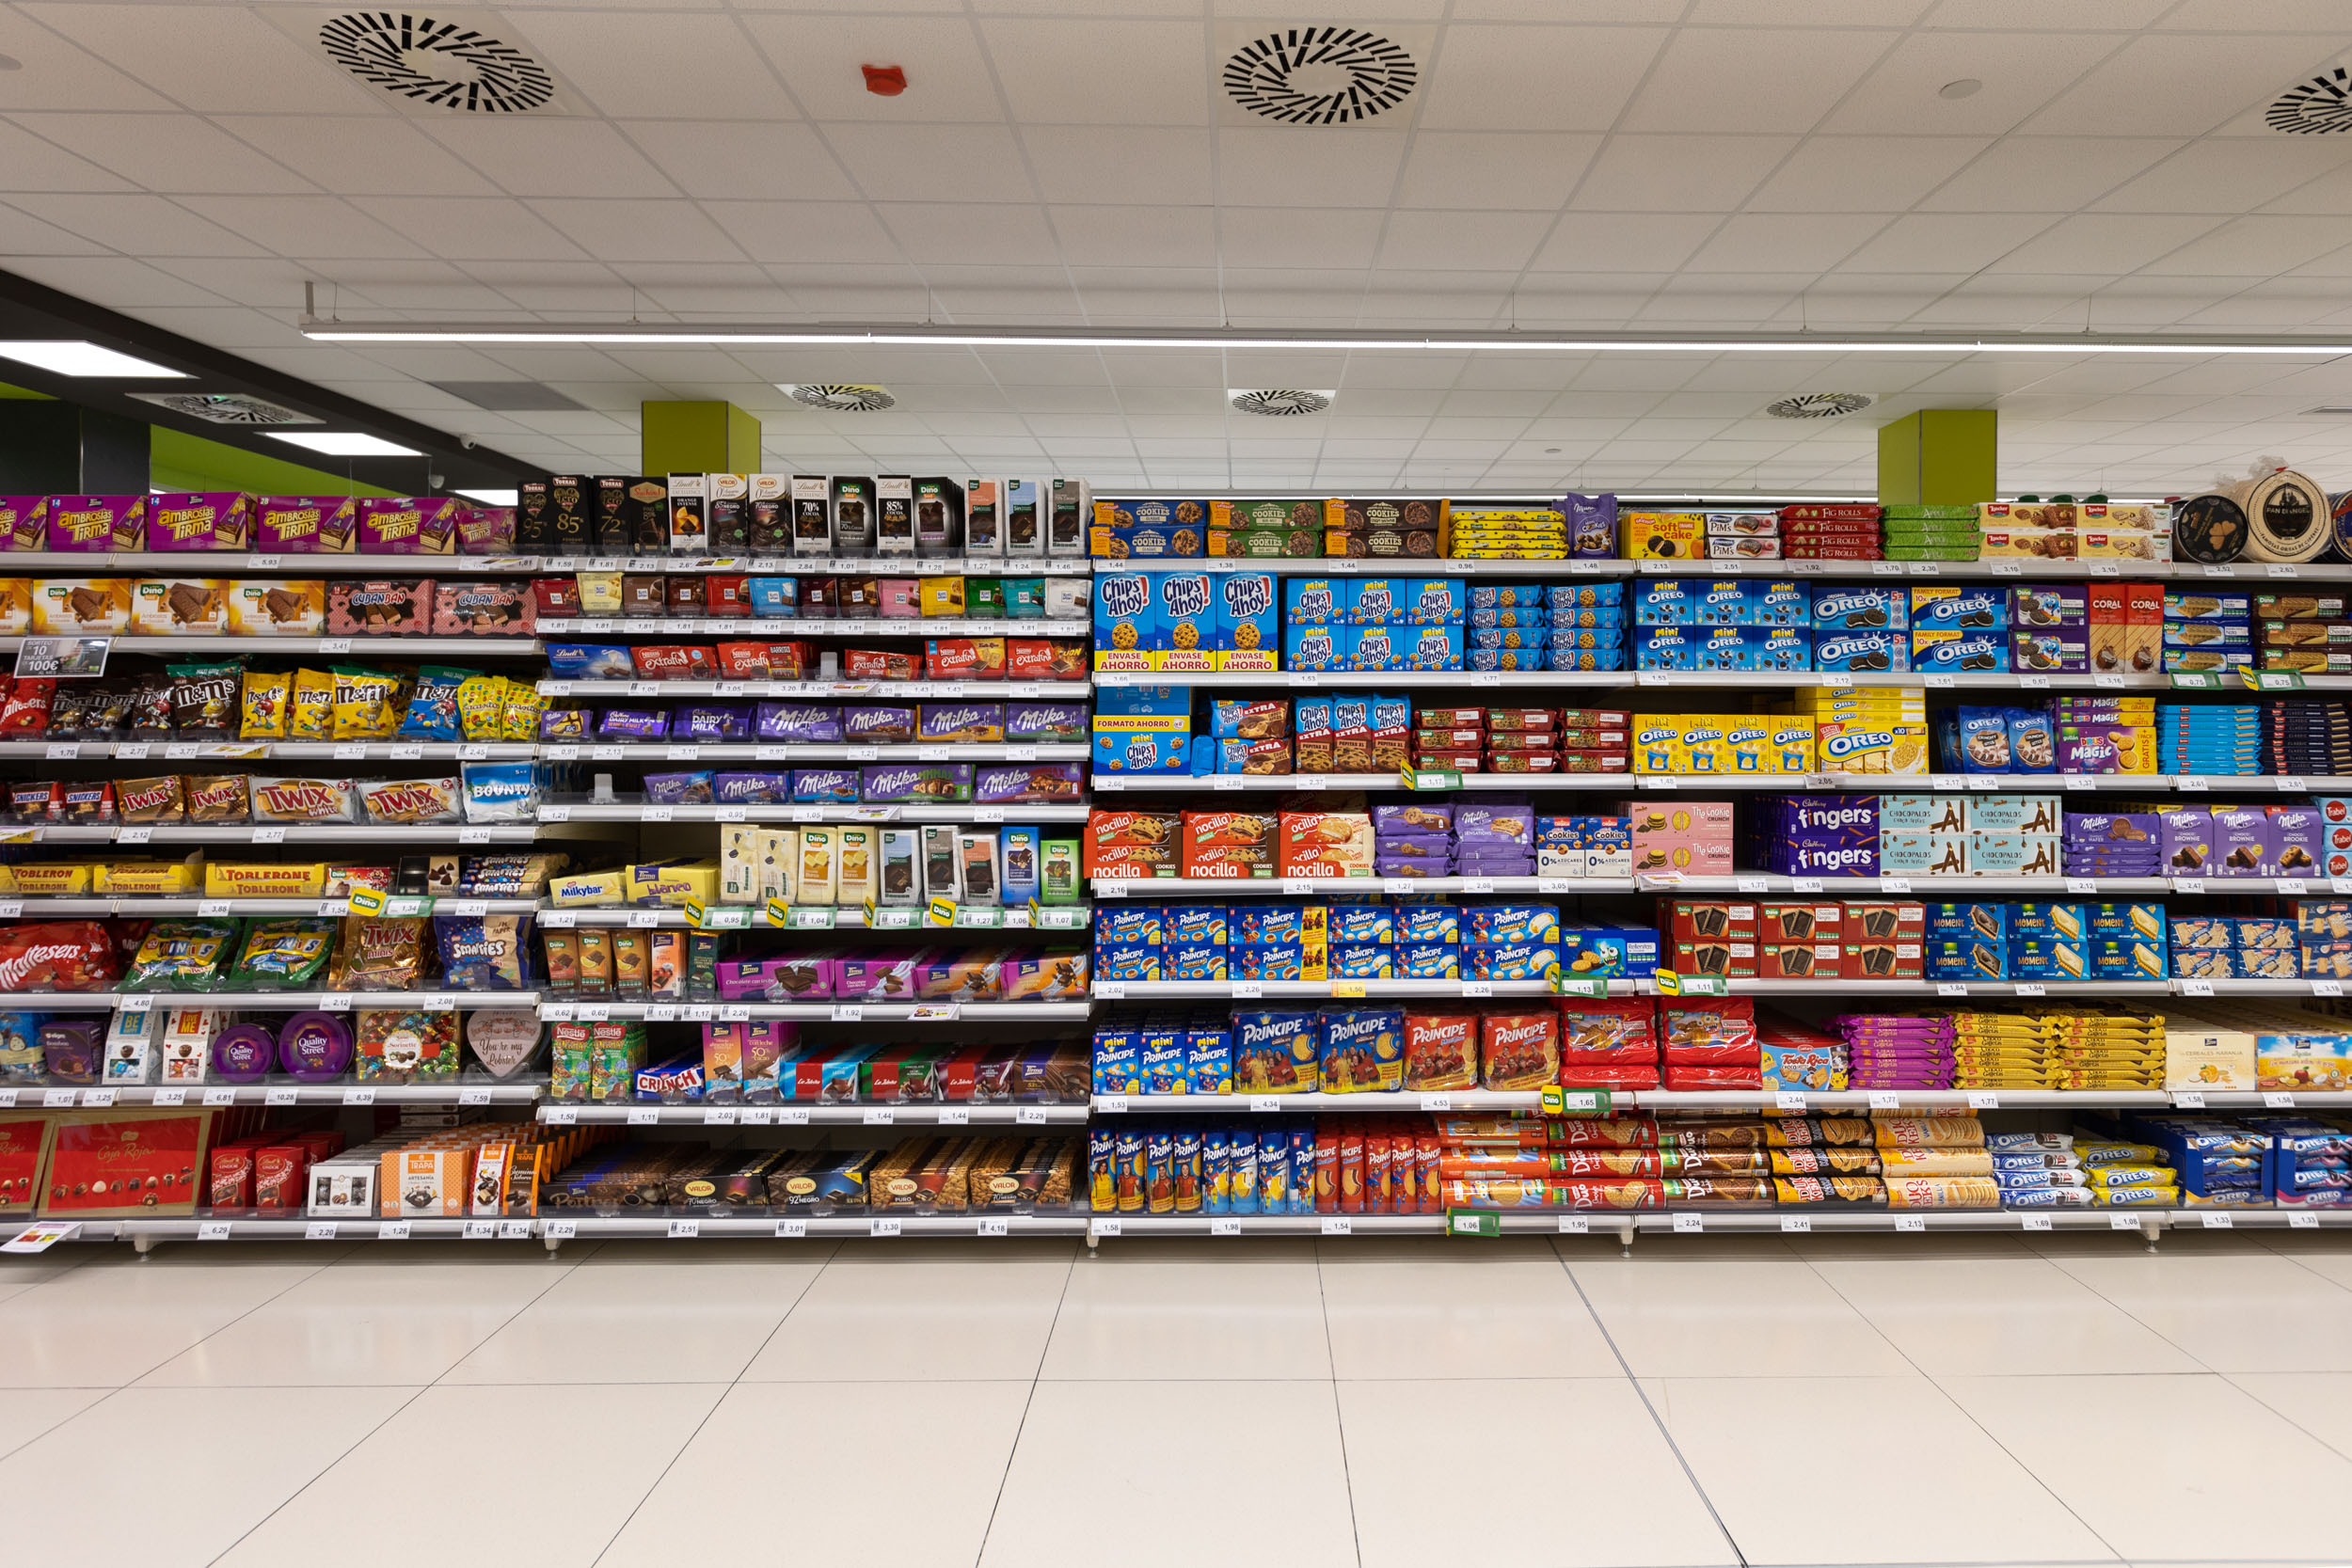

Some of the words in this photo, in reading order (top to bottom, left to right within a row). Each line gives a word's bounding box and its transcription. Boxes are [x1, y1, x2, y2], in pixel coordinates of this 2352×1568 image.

[842, 484, 860, 494] Dino
[803, 502, 819, 512] 70%
[886, 500, 903, 511] 85%
[1663, 531, 1692, 539] cake
[142, 585, 163, 595] Dino
[1102, 577, 1140, 601] Chips
[1163, 577, 1201, 601] Chips
[1224, 577, 1263, 601] Chips
[1300, 592, 1327, 606] Chips
[1648, 591, 1684, 603] OREO
[1707, 591, 1742, 603] OREO
[1816, 596, 1877, 618] OREO
[1934, 598, 1984, 617] OREO
[2093, 599, 2122, 610] CORAL
[2131, 600, 2159, 610] CORAL
[33, 646, 46, 655] 10
[1820, 640, 1880, 660] OREO
[29, 661, 58, 671] 100€
[1101, 660, 1150, 670] AHORRO
[1162, 660, 1211, 670] AHORRO
[1223, 660, 1272, 670] AHORRO
[692, 715, 723, 724] DAIRY
[850, 713, 894, 730] Milka
[931, 711, 978, 732] Milka
[1016, 709, 1067, 730] Milka
[691, 722, 715, 732] MILK
[1640, 730, 1677, 742] OREO
[1683, 730, 1723, 742] OREO
[1829, 732, 1893, 755] OREO
[2142, 739, 2151, 768] GRATIS
[871, 769, 919, 794] Milka
[14, 791, 49, 801] SNICKERS
[473, 784, 531, 798] BOUNTY
[724, 781, 767, 798] Milka
[1798, 808, 1871, 830] fingers
[1798, 848, 1871, 870] fingers
[1093, 863, 1140, 878] nocilla
[1191, 863, 1237, 878] nocilla
[562, 885, 603, 898] Milkybar
[355, 897, 377, 909] Dino
[933, 906, 951, 916] Dino
[1114, 912, 1145, 924] PRINCIPE
[1264, 912, 1295, 925] PRINCIPE
[1494, 911, 1530, 926] PRINCIPE
[125, 1014, 139, 1028] BE
[1243, 1020, 1302, 1044] PRINCIPE
[1412, 1024, 1466, 1045] PRINCIPE
[298, 1037, 327, 1050] Quality
[302, 1045, 325, 1054] Street
[1096, 1048, 1136, 1065] PRINCIPE
[411, 1161, 434, 1170] TRAPA
[2107, 1172, 2148, 1186] OREO
[2112, 1189, 2153, 1203] OREO
